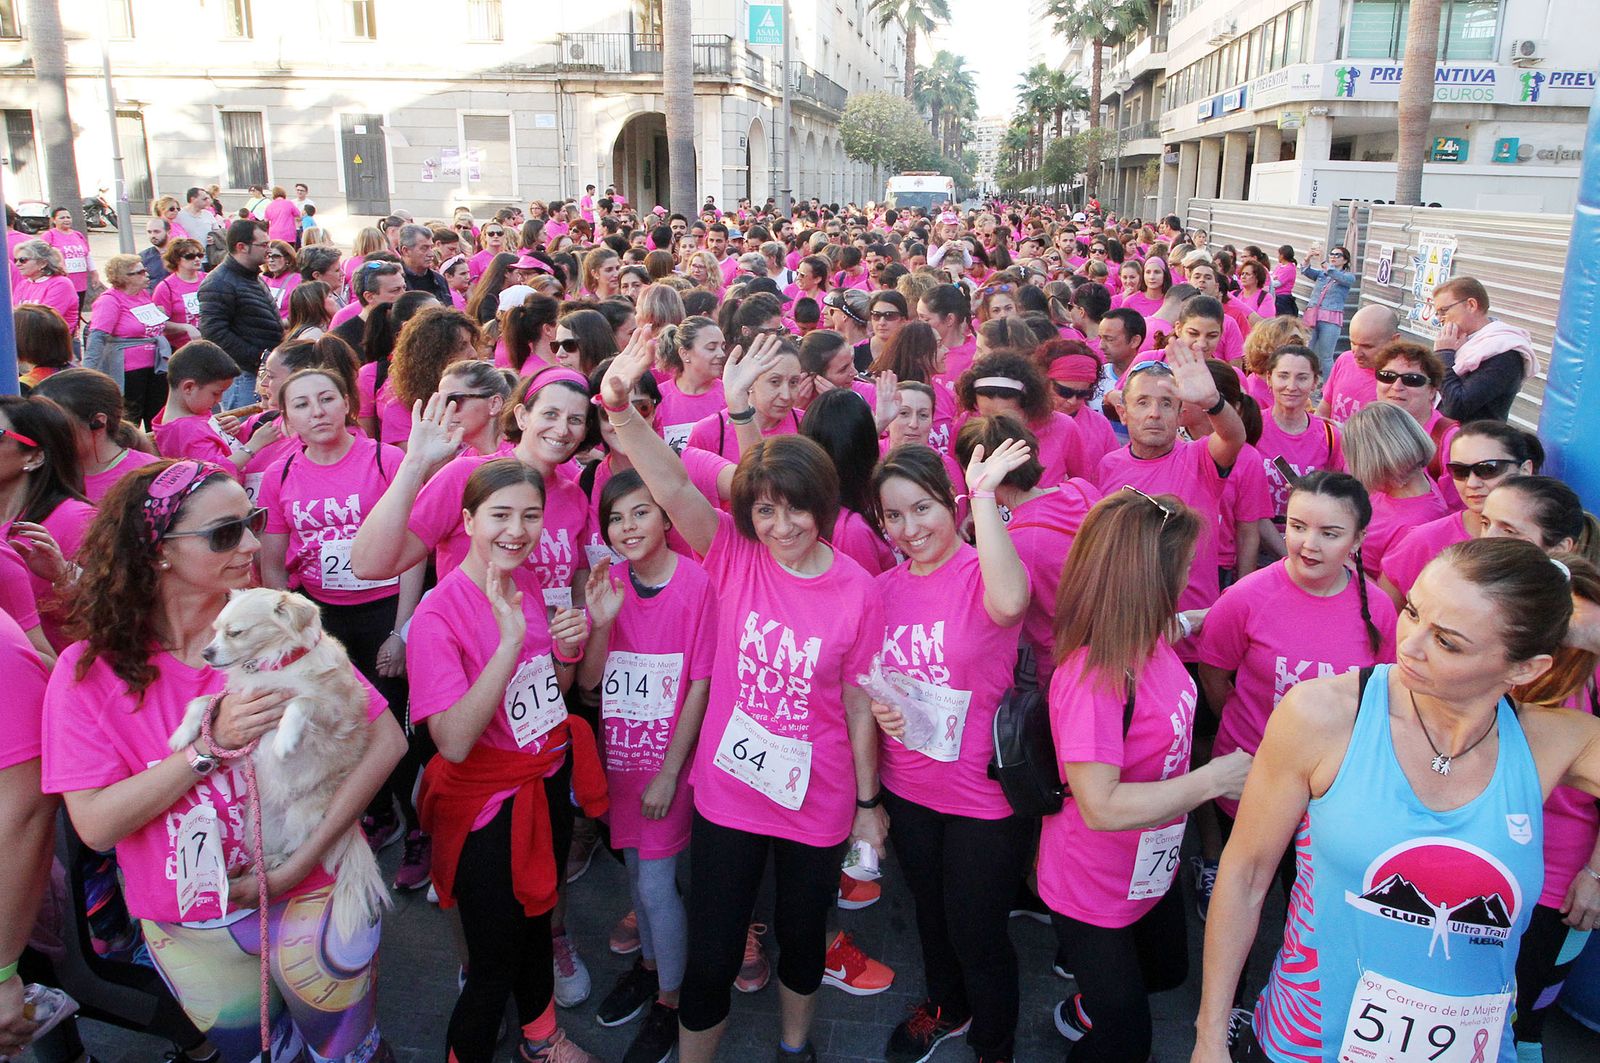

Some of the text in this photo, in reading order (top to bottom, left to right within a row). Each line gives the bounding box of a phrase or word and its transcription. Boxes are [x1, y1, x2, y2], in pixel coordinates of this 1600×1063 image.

[755, 28, 780, 36] ASAJA
[1369, 67, 1496, 83] PRENTIVA
[1436, 87, 1495, 101] GUROS
[292, 493, 361, 531] KM
[739, 610, 823, 680] KM
[880, 620, 945, 666] KM
[605, 669, 649, 698] 614
[737, 650, 812, 701] POR
[511, 674, 561, 721] 615
[732, 737, 767, 772] 64
[180, 831, 208, 879] 17
[1148, 845, 1180, 876] 78
[1379, 907, 1431, 927] CLUB
[1451, 922, 1508, 939] Ultra Trail
[1468, 936, 1505, 949] HUELVA
[1385, 987, 1438, 1014] Carrera
[1441, 1004, 1458, 1017] de
[1460, 1006, 1470, 1017] la
[1472, 1003, 1504, 1016] Mujer
[1353, 1002, 1457, 1062] 519
[1459, 1016, 1500, 1027] Huelva 2019
